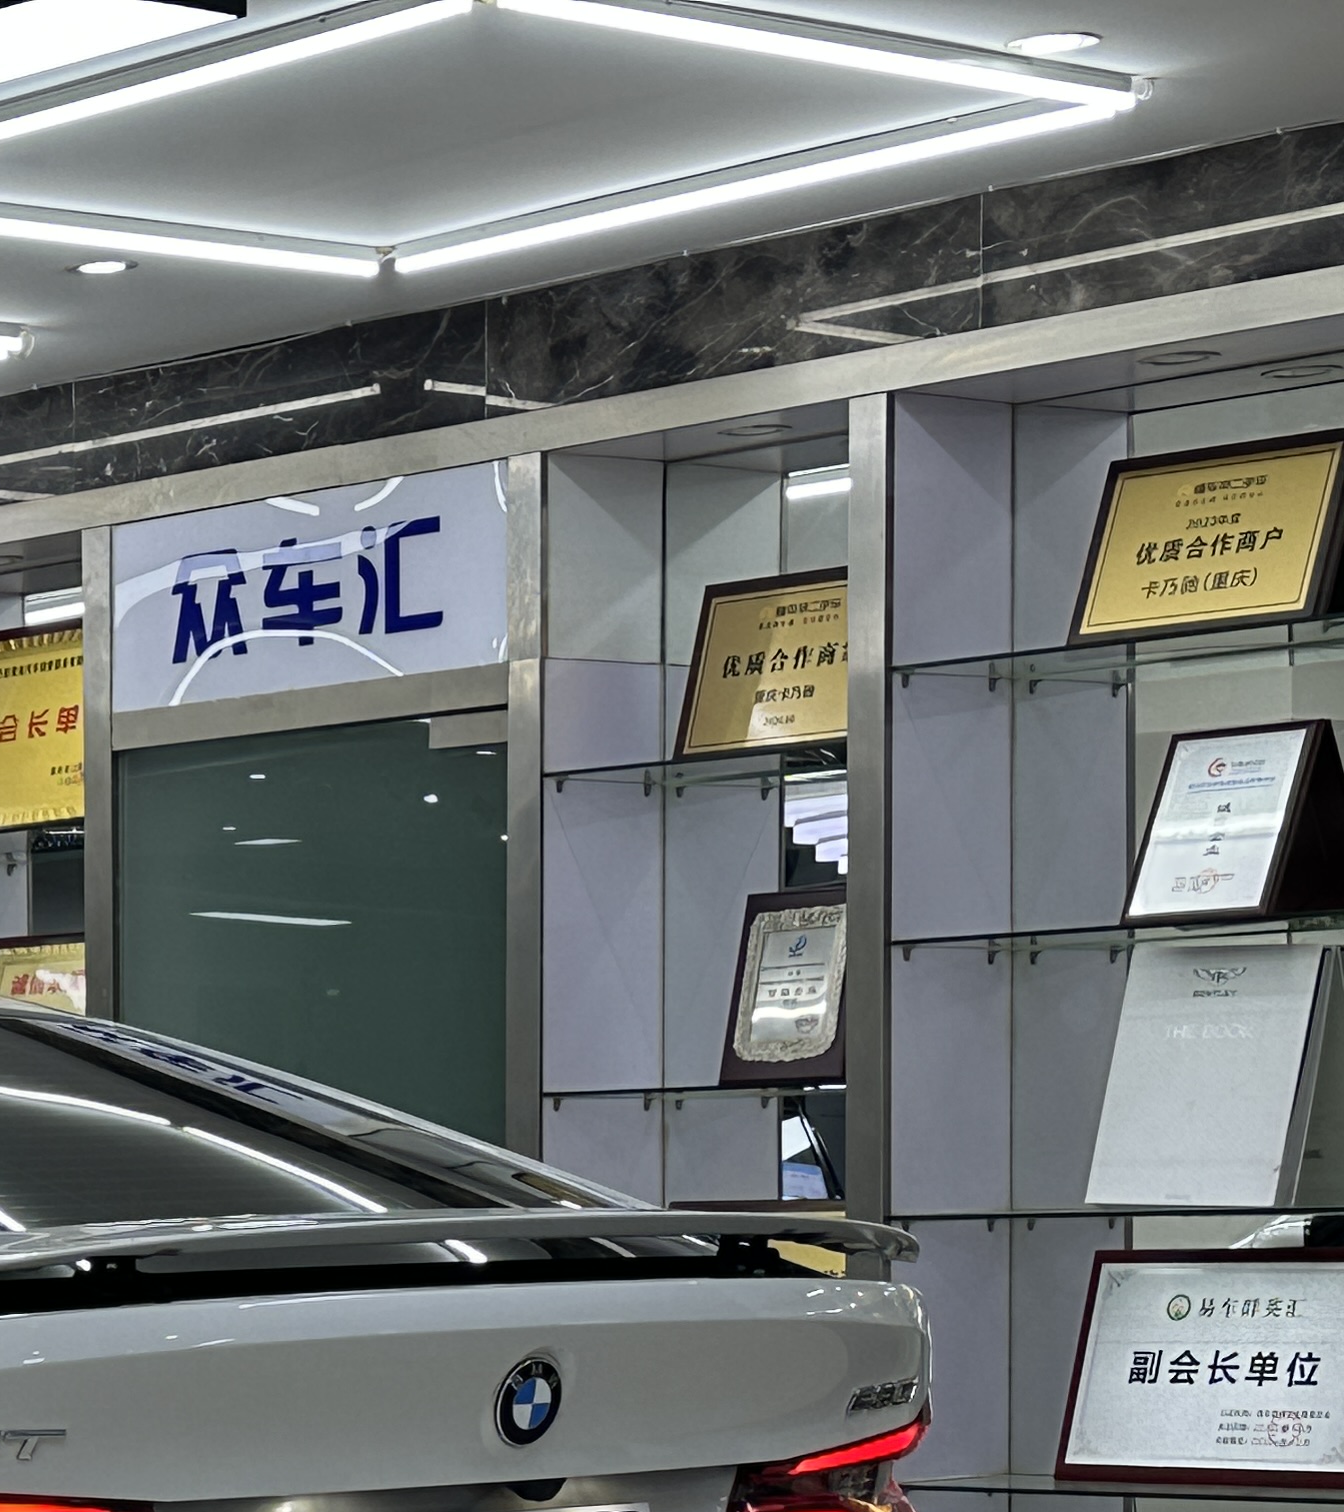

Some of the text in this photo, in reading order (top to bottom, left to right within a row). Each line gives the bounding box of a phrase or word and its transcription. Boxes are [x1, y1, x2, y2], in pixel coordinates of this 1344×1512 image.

[171, 515, 444, 664] 众车汇
[1128, 1350, 1322, 1388] 副会长单位
